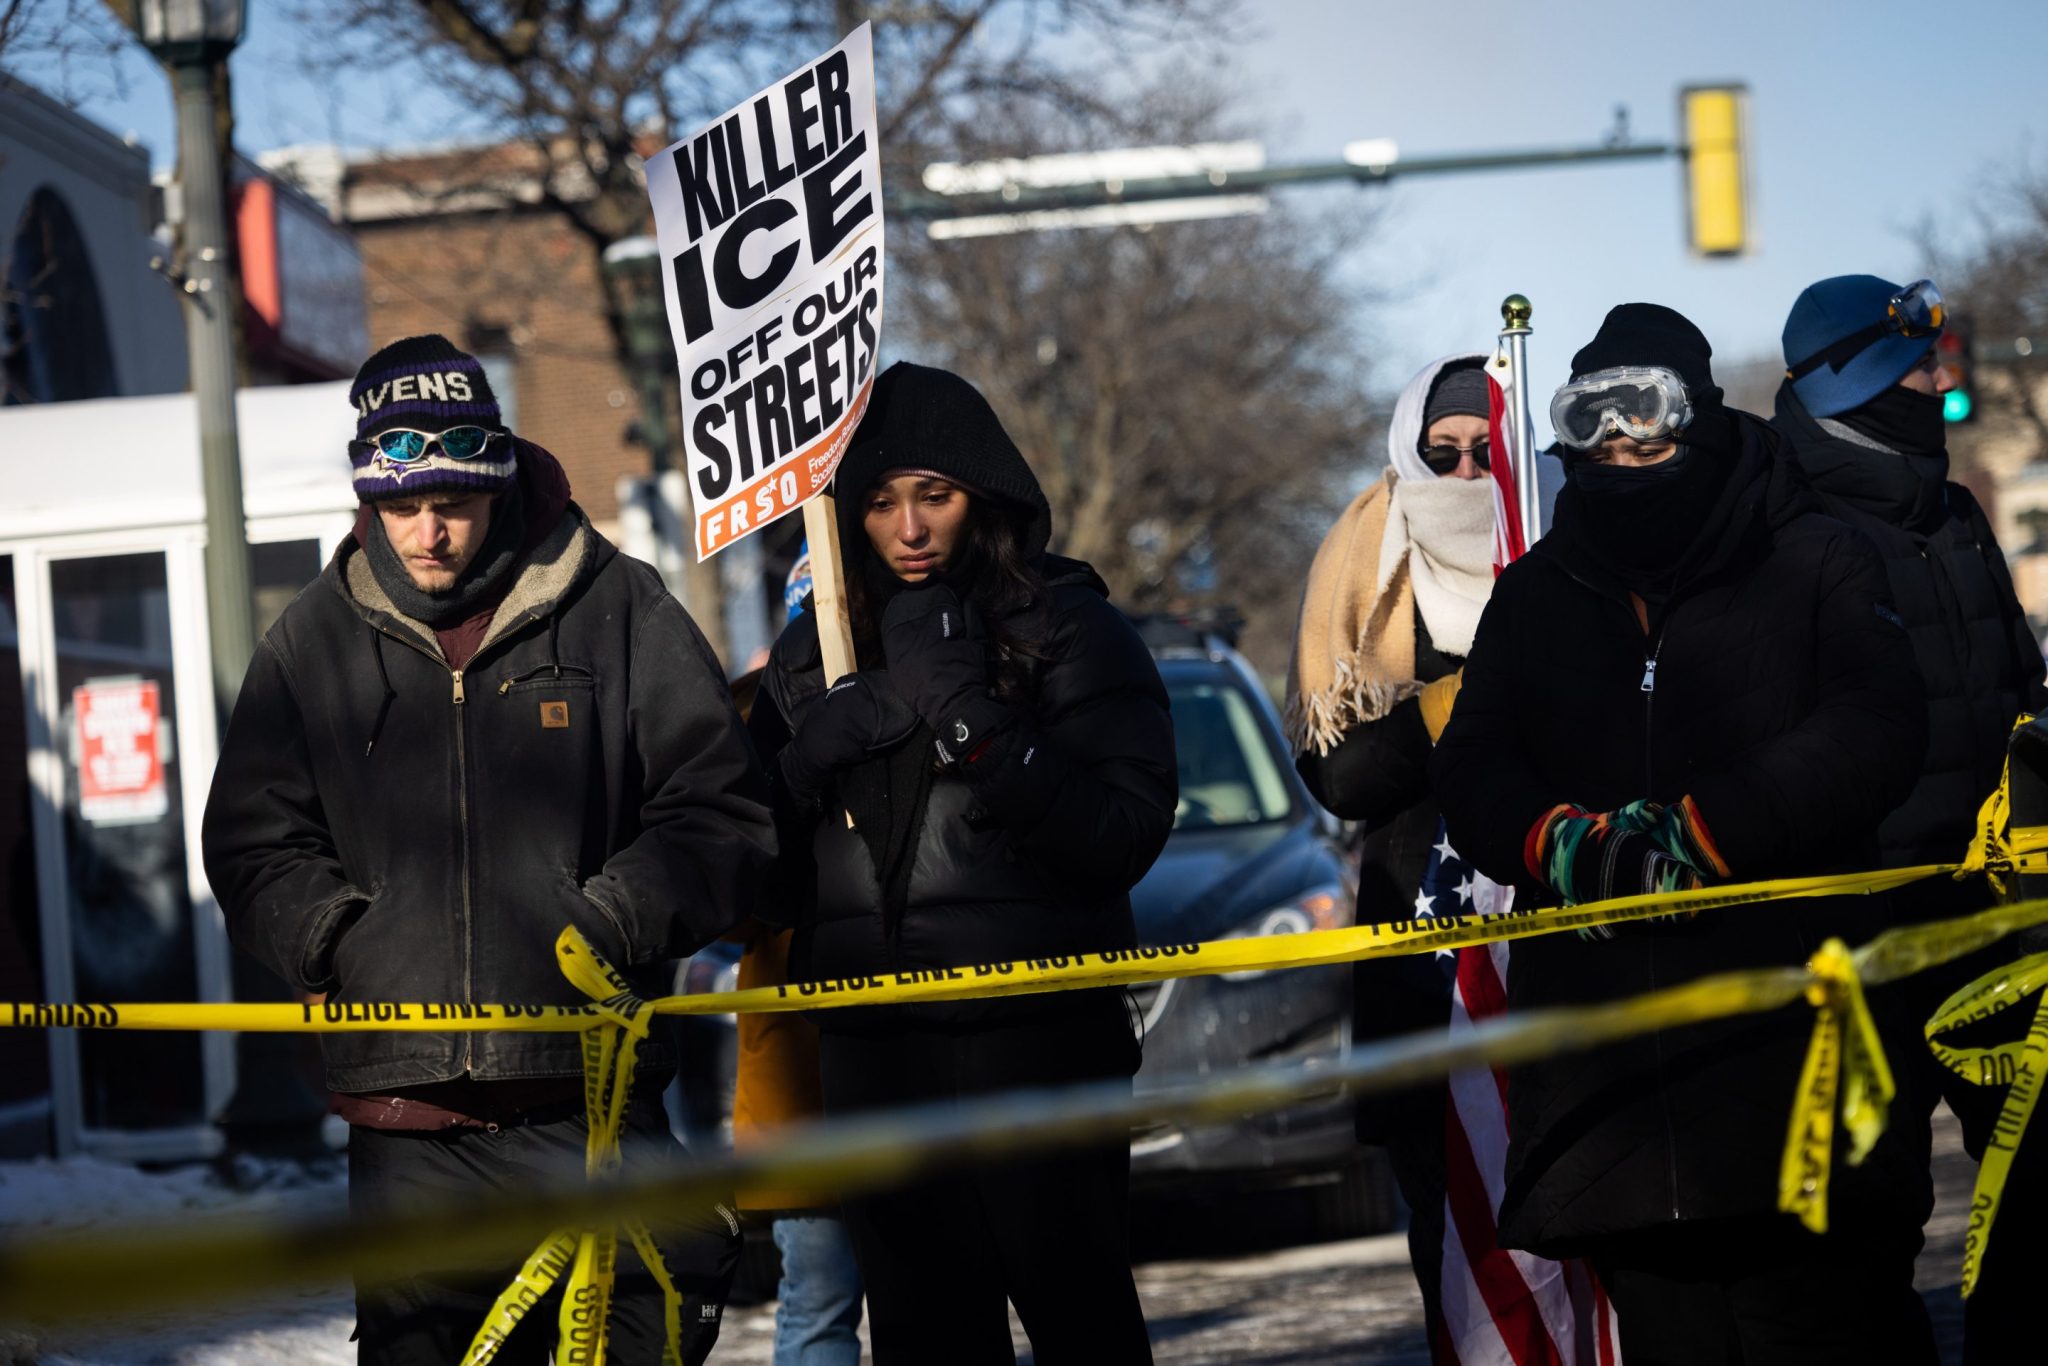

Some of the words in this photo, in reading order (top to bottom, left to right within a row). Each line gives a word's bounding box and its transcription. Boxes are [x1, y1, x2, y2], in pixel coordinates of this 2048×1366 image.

[672, 49, 853, 244] KILLER
[673, 129, 874, 345] ICE
[691, 315, 783, 400] OFF
[792, 245, 877, 337] OUR
[692, 287, 878, 501] STREETS
[807, 436, 842, 474] Freedom
